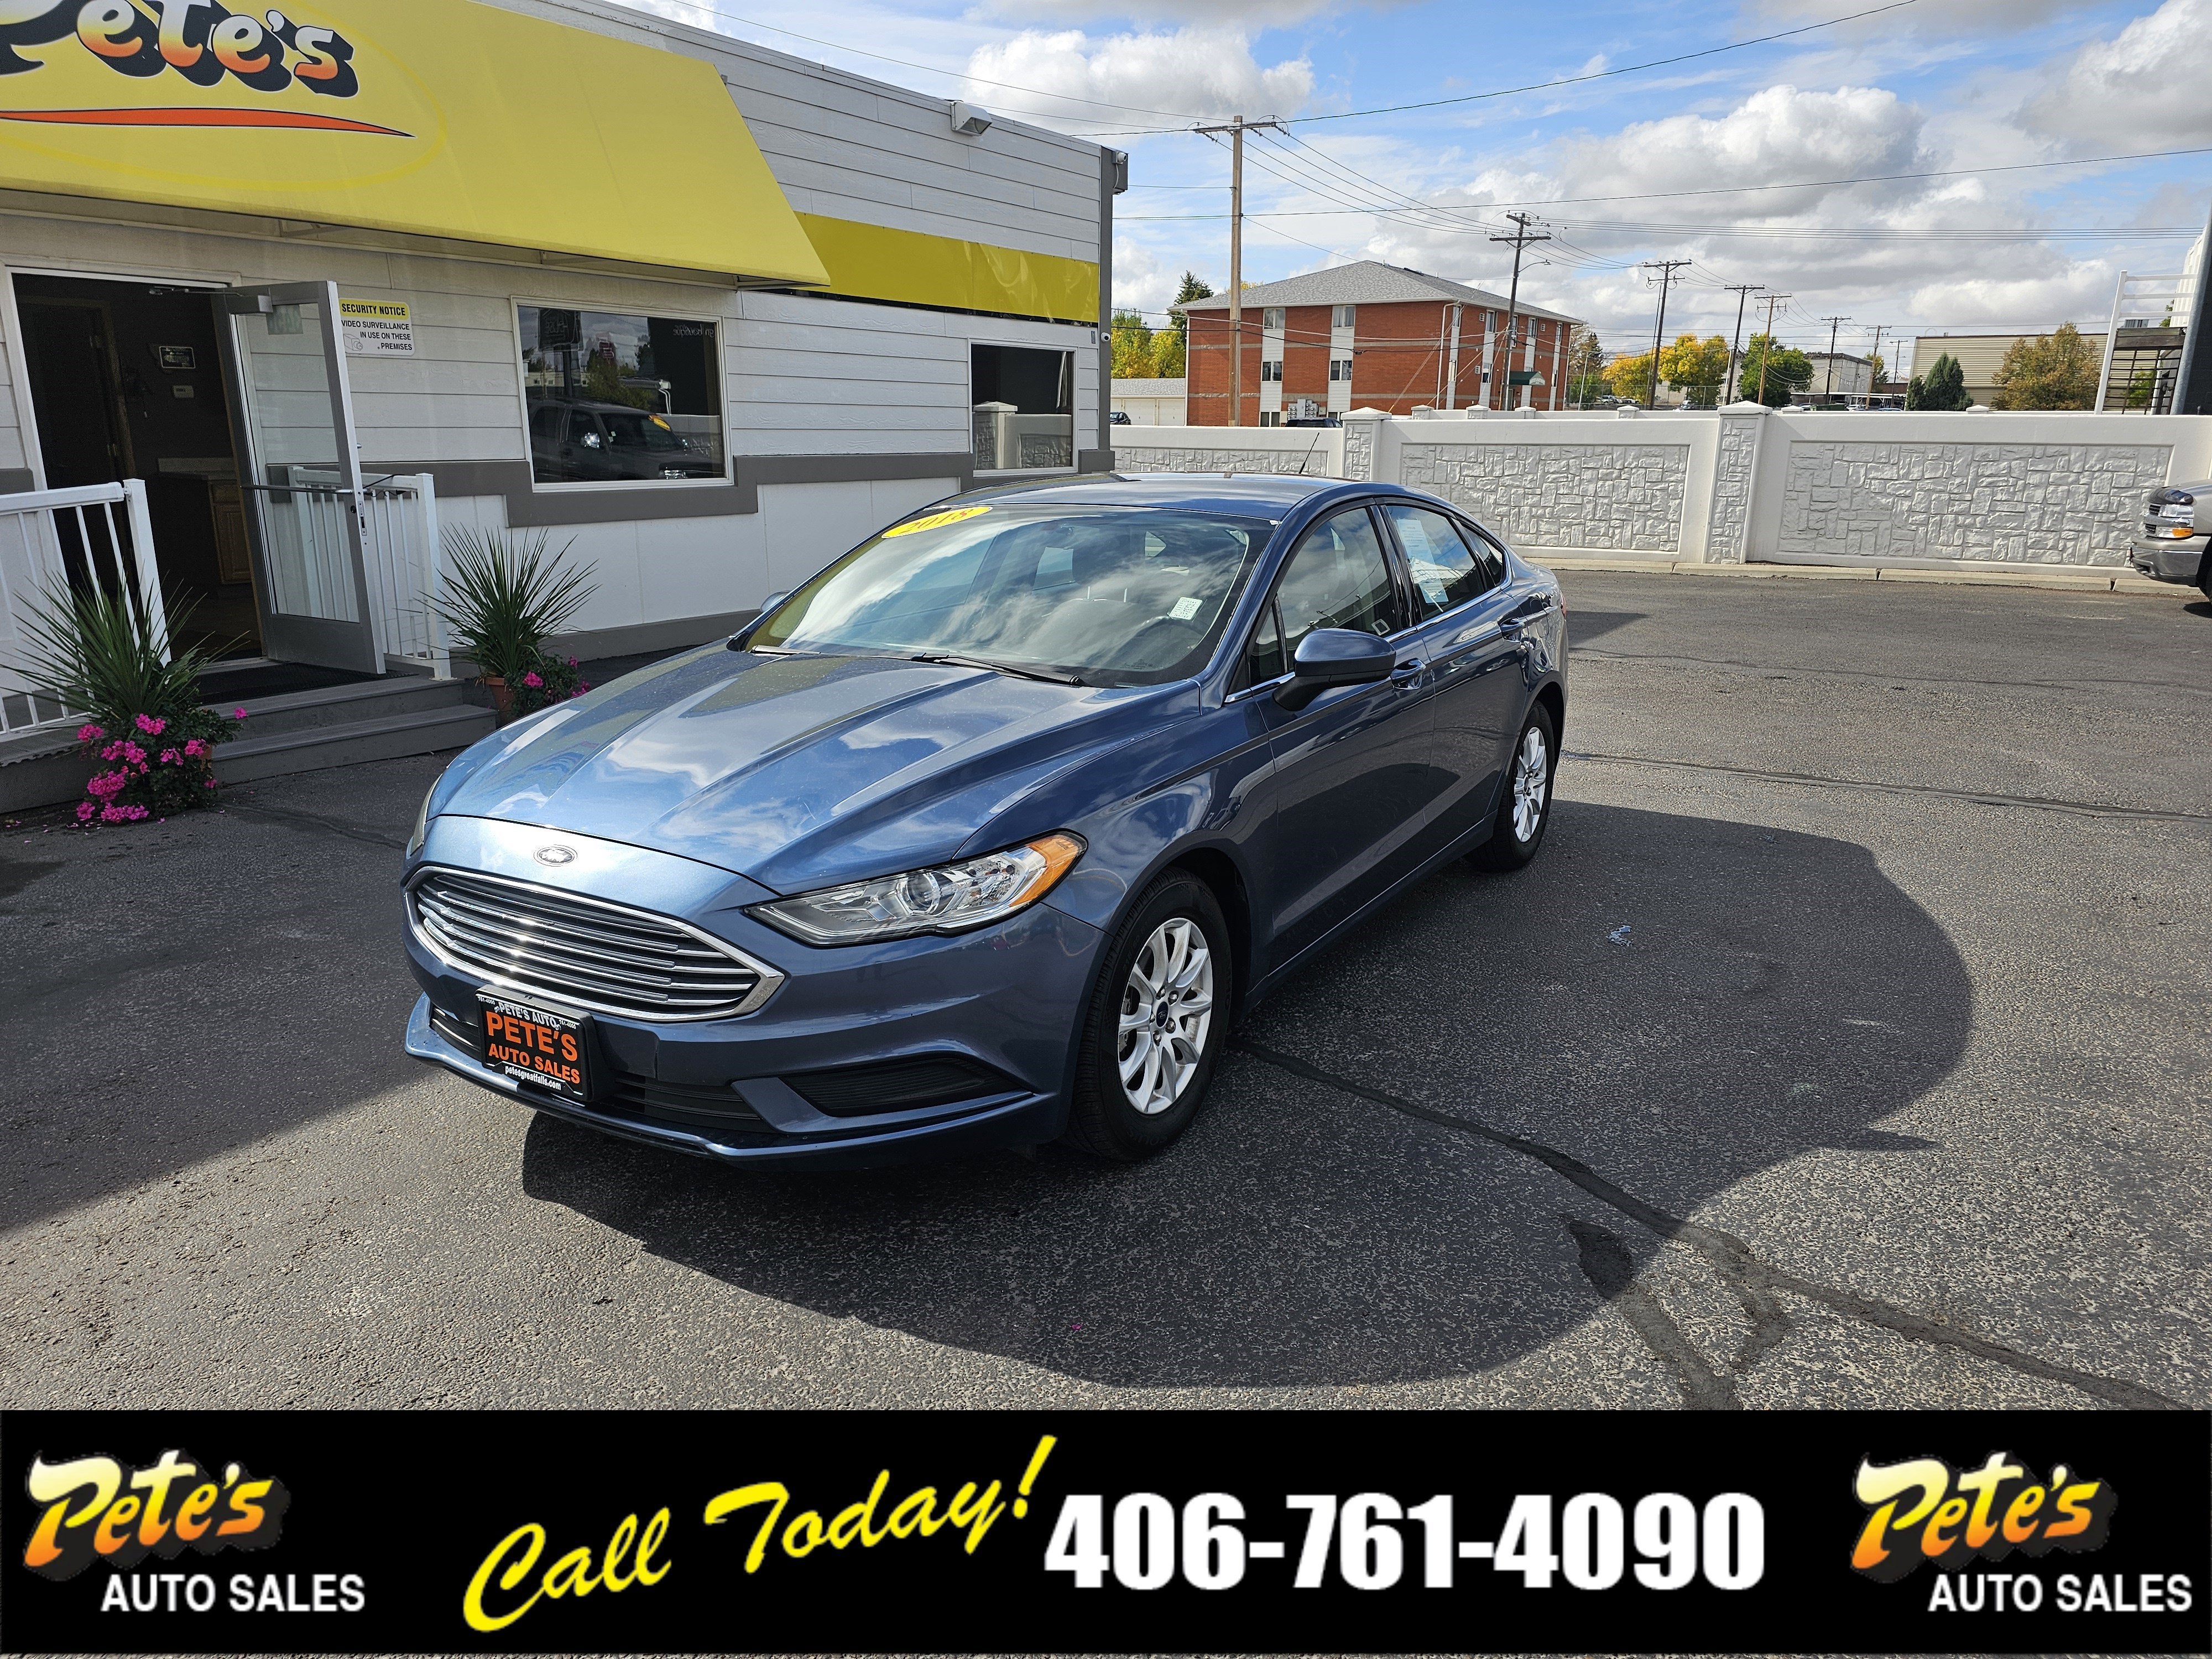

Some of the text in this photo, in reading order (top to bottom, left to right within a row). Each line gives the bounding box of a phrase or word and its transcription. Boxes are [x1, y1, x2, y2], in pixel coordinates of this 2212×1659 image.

[342, 304, 406, 316] SECURITY NOTICE
[363, 321, 410, 330] SURVEILLANCE
[498, 1001, 557, 1028] PETE'S AUTO
[486, 1010, 578, 1062] PETE'S
[489, 1043, 580, 1084] AUTO SALES
[505, 1066, 561, 1091] petesgreatfalls.com
